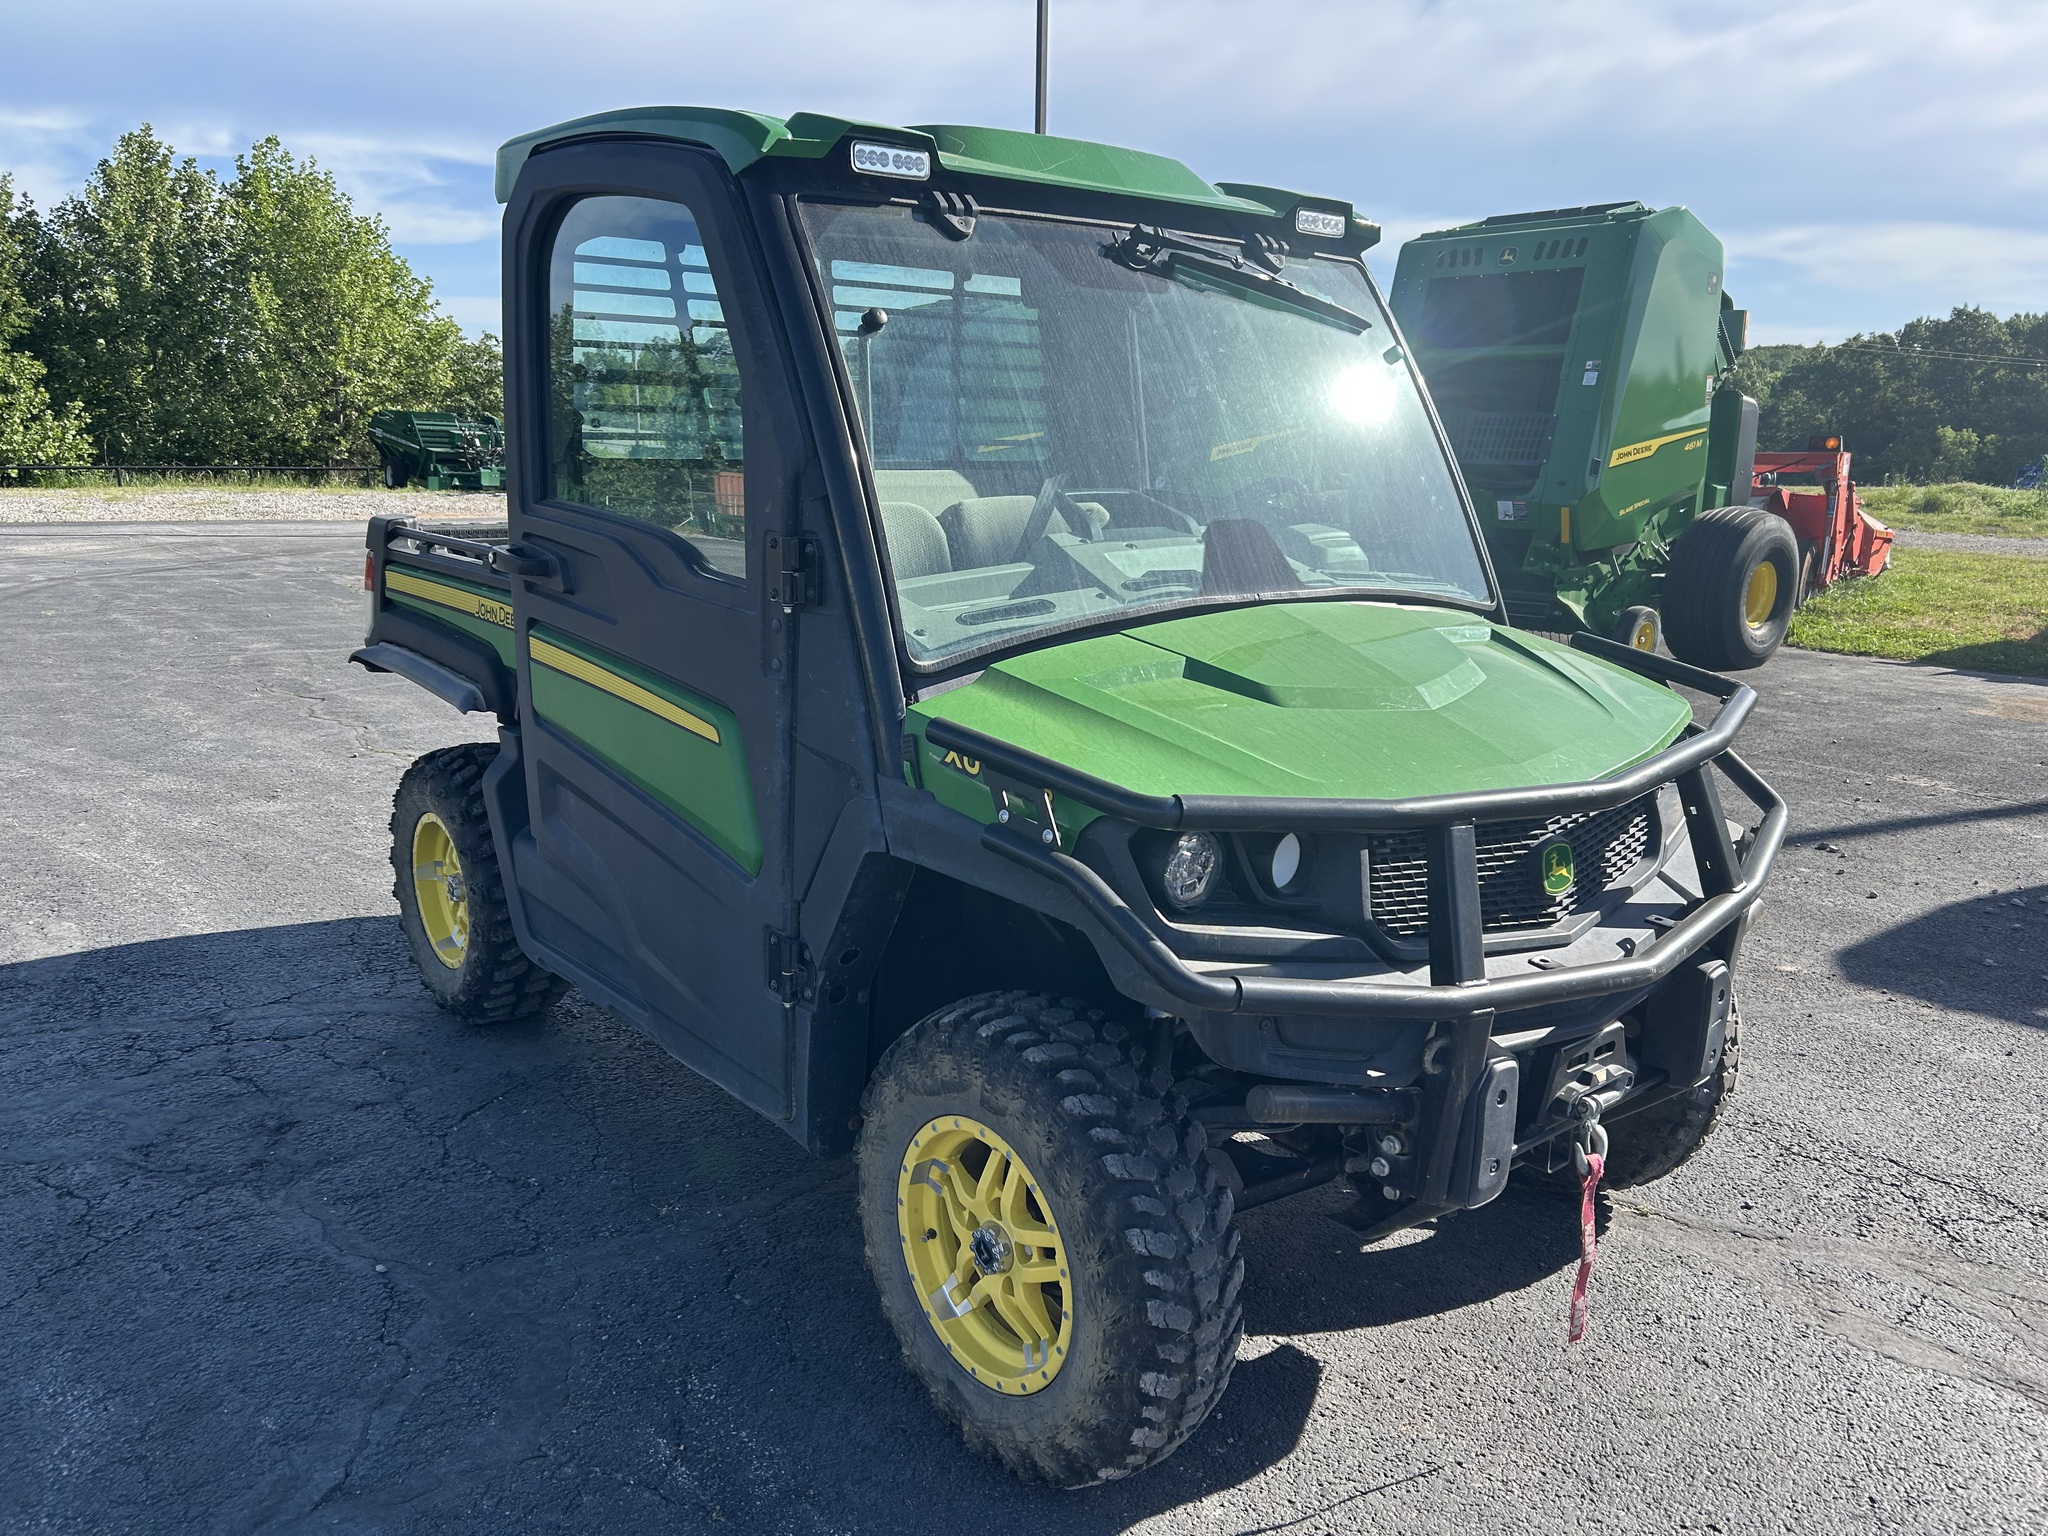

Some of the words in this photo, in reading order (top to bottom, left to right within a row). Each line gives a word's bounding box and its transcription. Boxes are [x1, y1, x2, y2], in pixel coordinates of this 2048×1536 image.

[1616, 449, 1632, 460] JOHN
[1632, 444, 1652, 456] DEERE
[475, 599, 498, 622] JOHN
[498, 606, 515, 627] DEE
